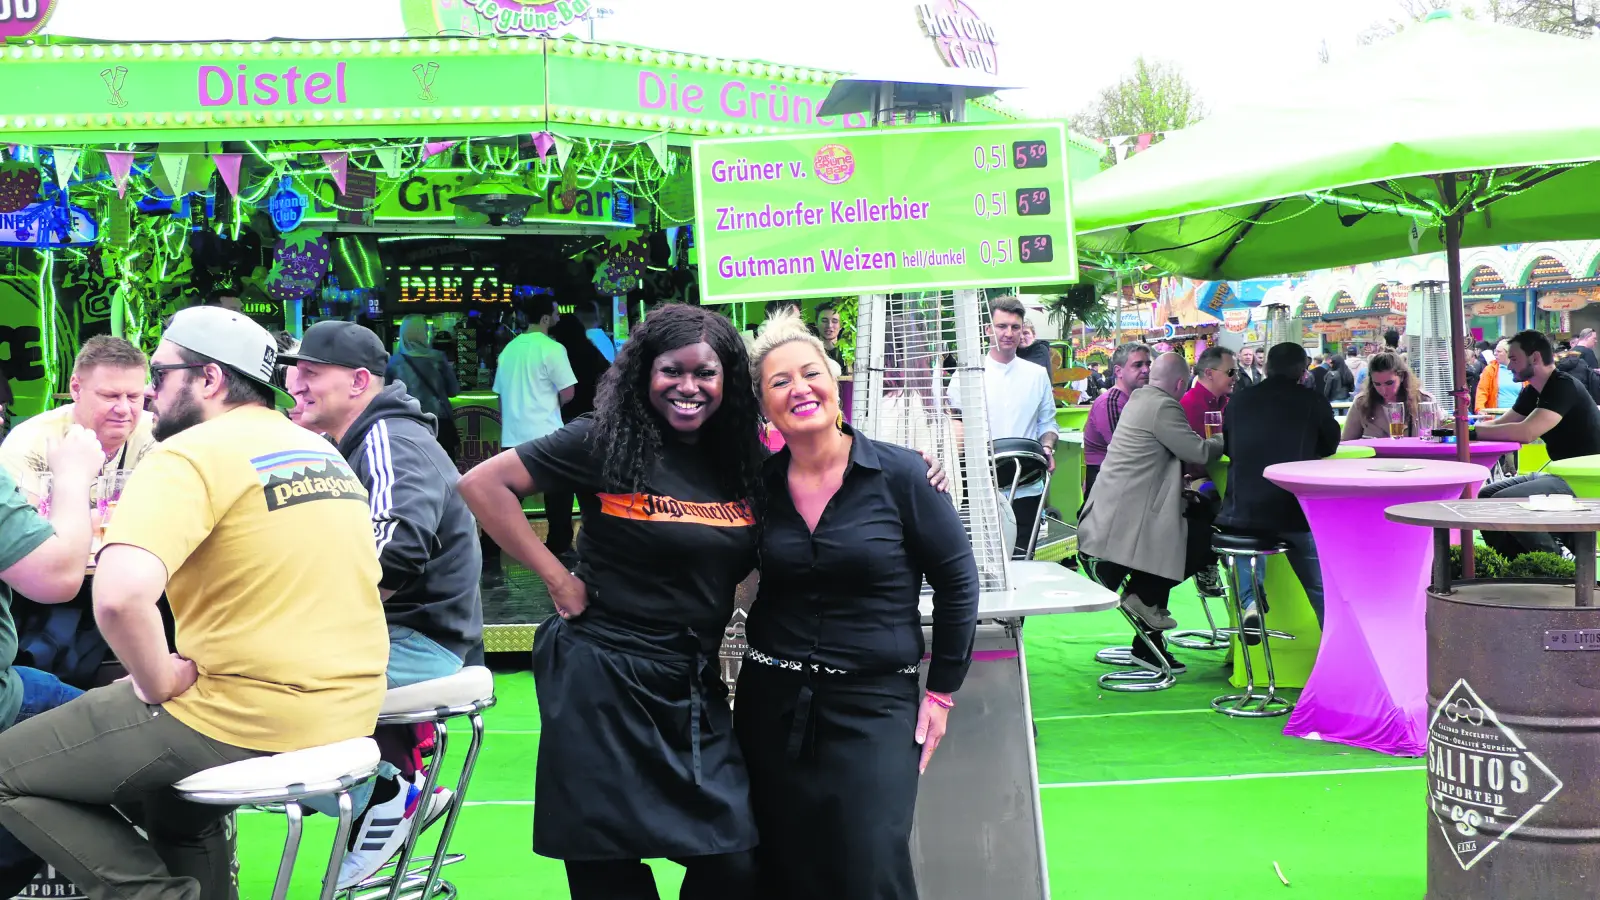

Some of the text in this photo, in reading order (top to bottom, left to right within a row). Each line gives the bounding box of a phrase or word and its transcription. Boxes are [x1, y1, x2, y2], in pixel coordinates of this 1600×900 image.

[500, 7, 557, 29] grüne
[917, 3, 996, 45] Havana
[947, 41, 995, 74] Club
[198, 62, 347, 107] Distel
[638, 71, 705, 114] Die
[711, 158, 783, 183] Grüner
[789, 161, 807, 178] v.
[275, 209, 298, 222] Club
[715, 201, 825, 231] Zirndorfer
[830, 196, 930, 224] Kellerbier
[718, 255, 815, 279] Gutmann
[820, 246, 897, 272] Weizen
[902, 247, 966, 269] hell/dunkel
[273, 476, 369, 506] patagon
[1429, 740, 1529, 793] SALITOS
[1436, 779, 1504, 806] IMPORTED
